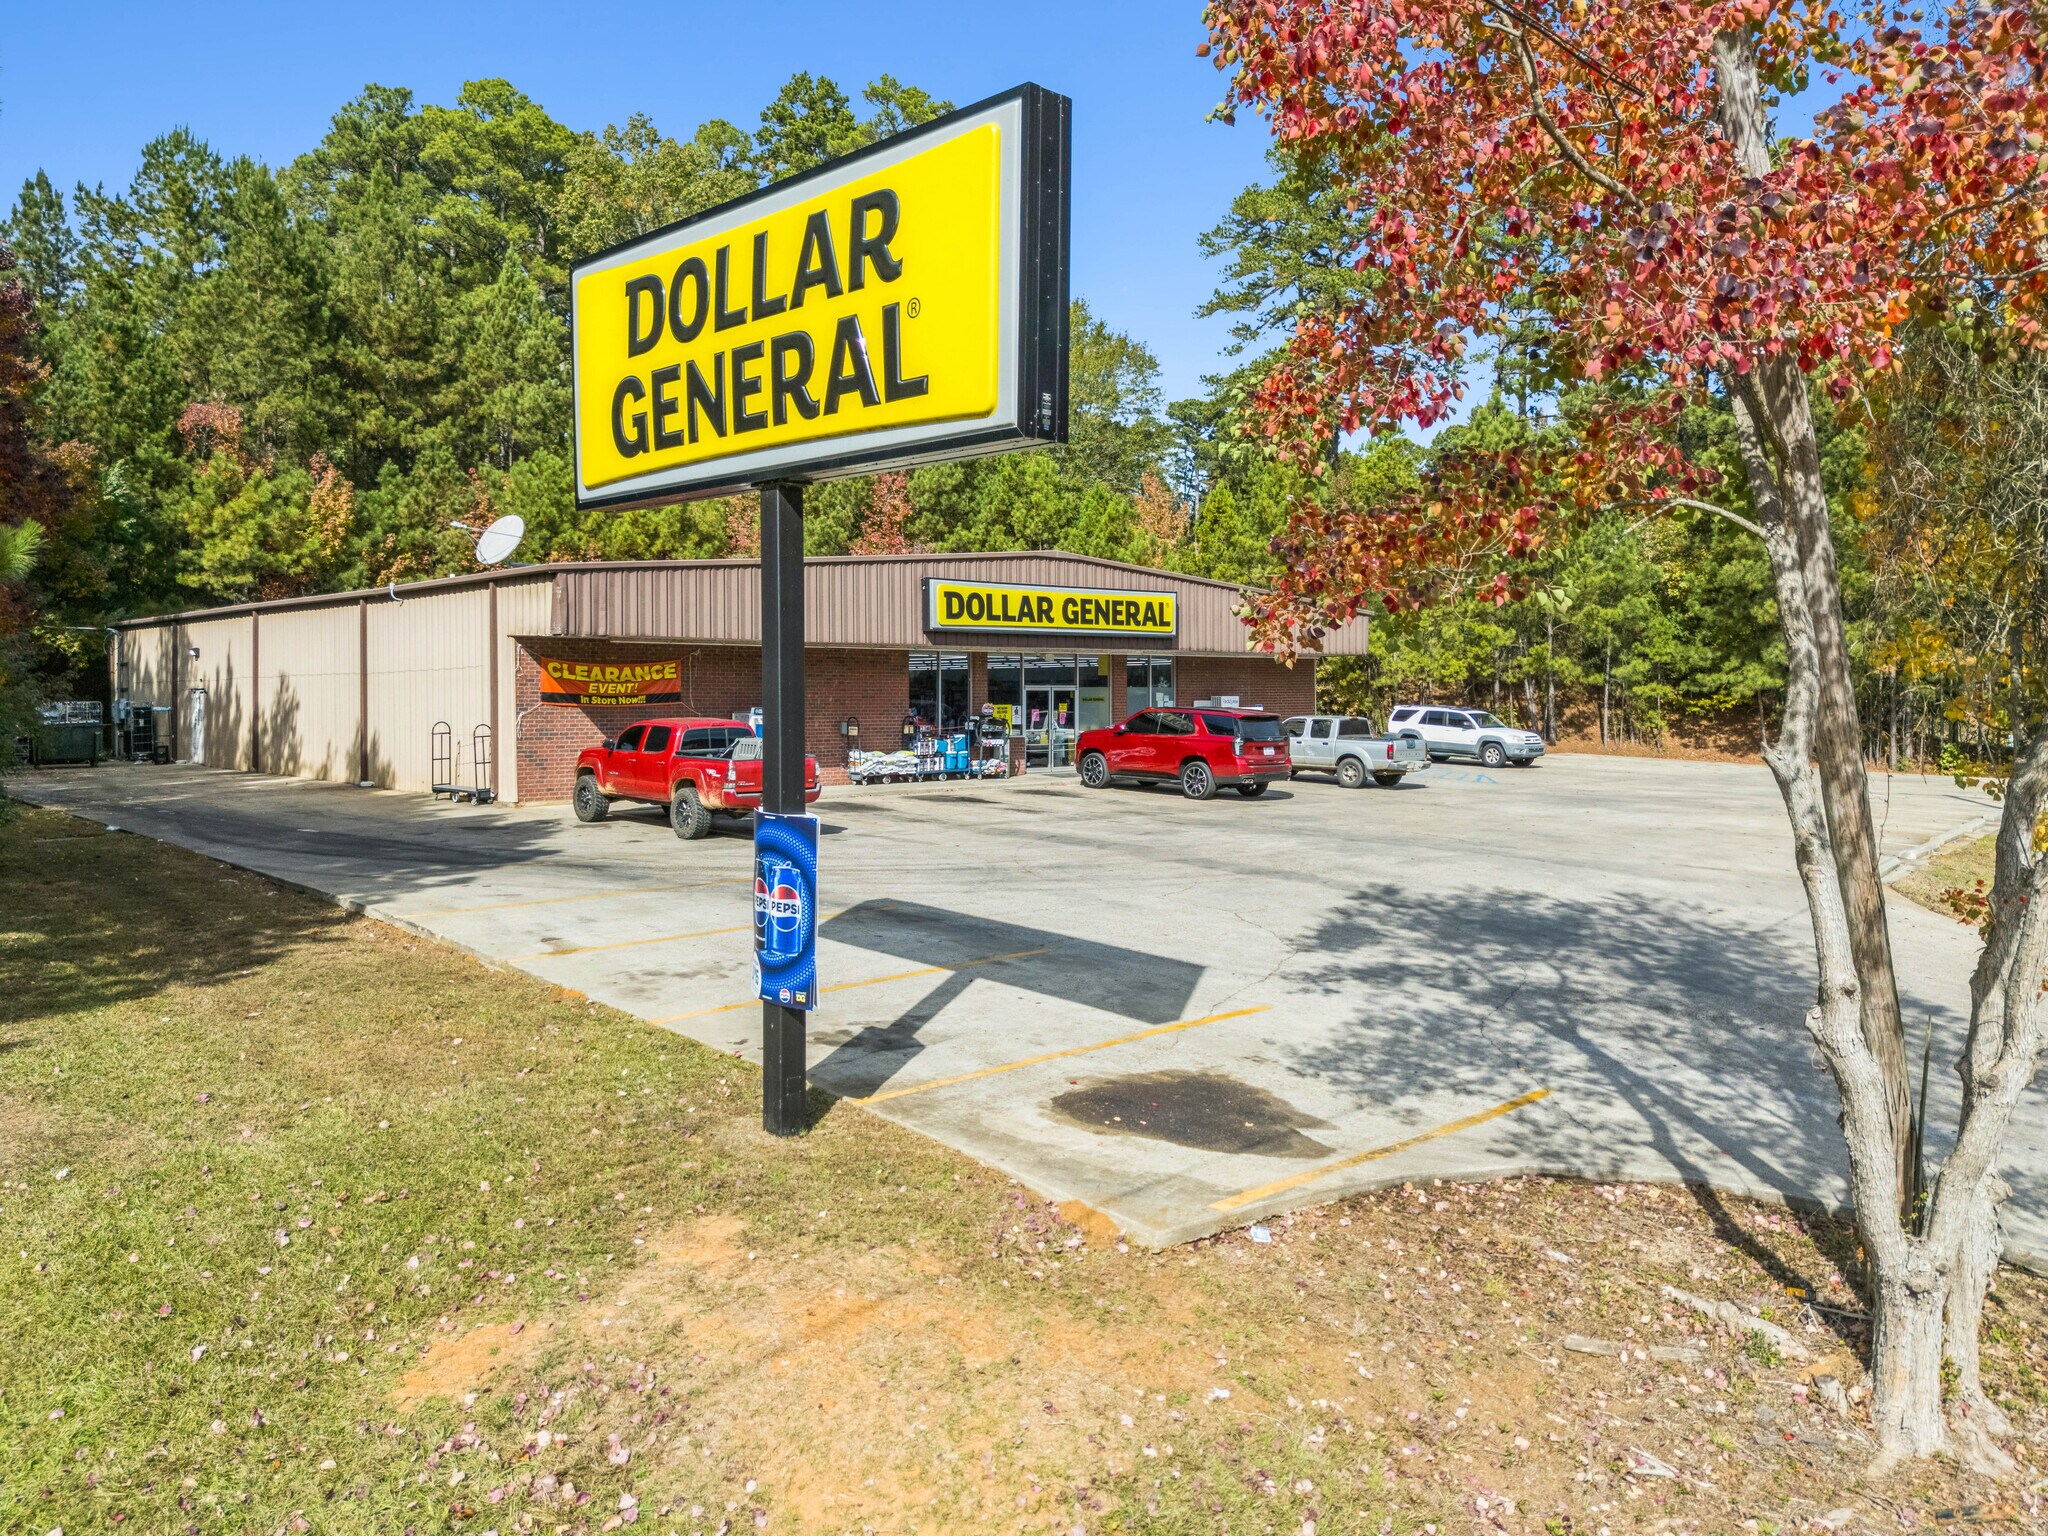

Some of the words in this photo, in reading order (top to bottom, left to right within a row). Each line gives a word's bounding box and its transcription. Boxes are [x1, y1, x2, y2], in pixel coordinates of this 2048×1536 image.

[625, 188, 903, 358] DOLLAR
[611, 302, 929, 458] GENERAL
[944, 591, 1054, 622] DOLLAR
[1062, 597, 1171, 627] GENERAL
[547, 661, 677, 682] CLEARANCE
[588, 682, 638, 694] EVENT!
[580, 695, 590, 704] In
[592, 696, 617, 705] Store
[618, 695, 646, 704] Now!!!
[771, 900, 800, 915] PEPSI
